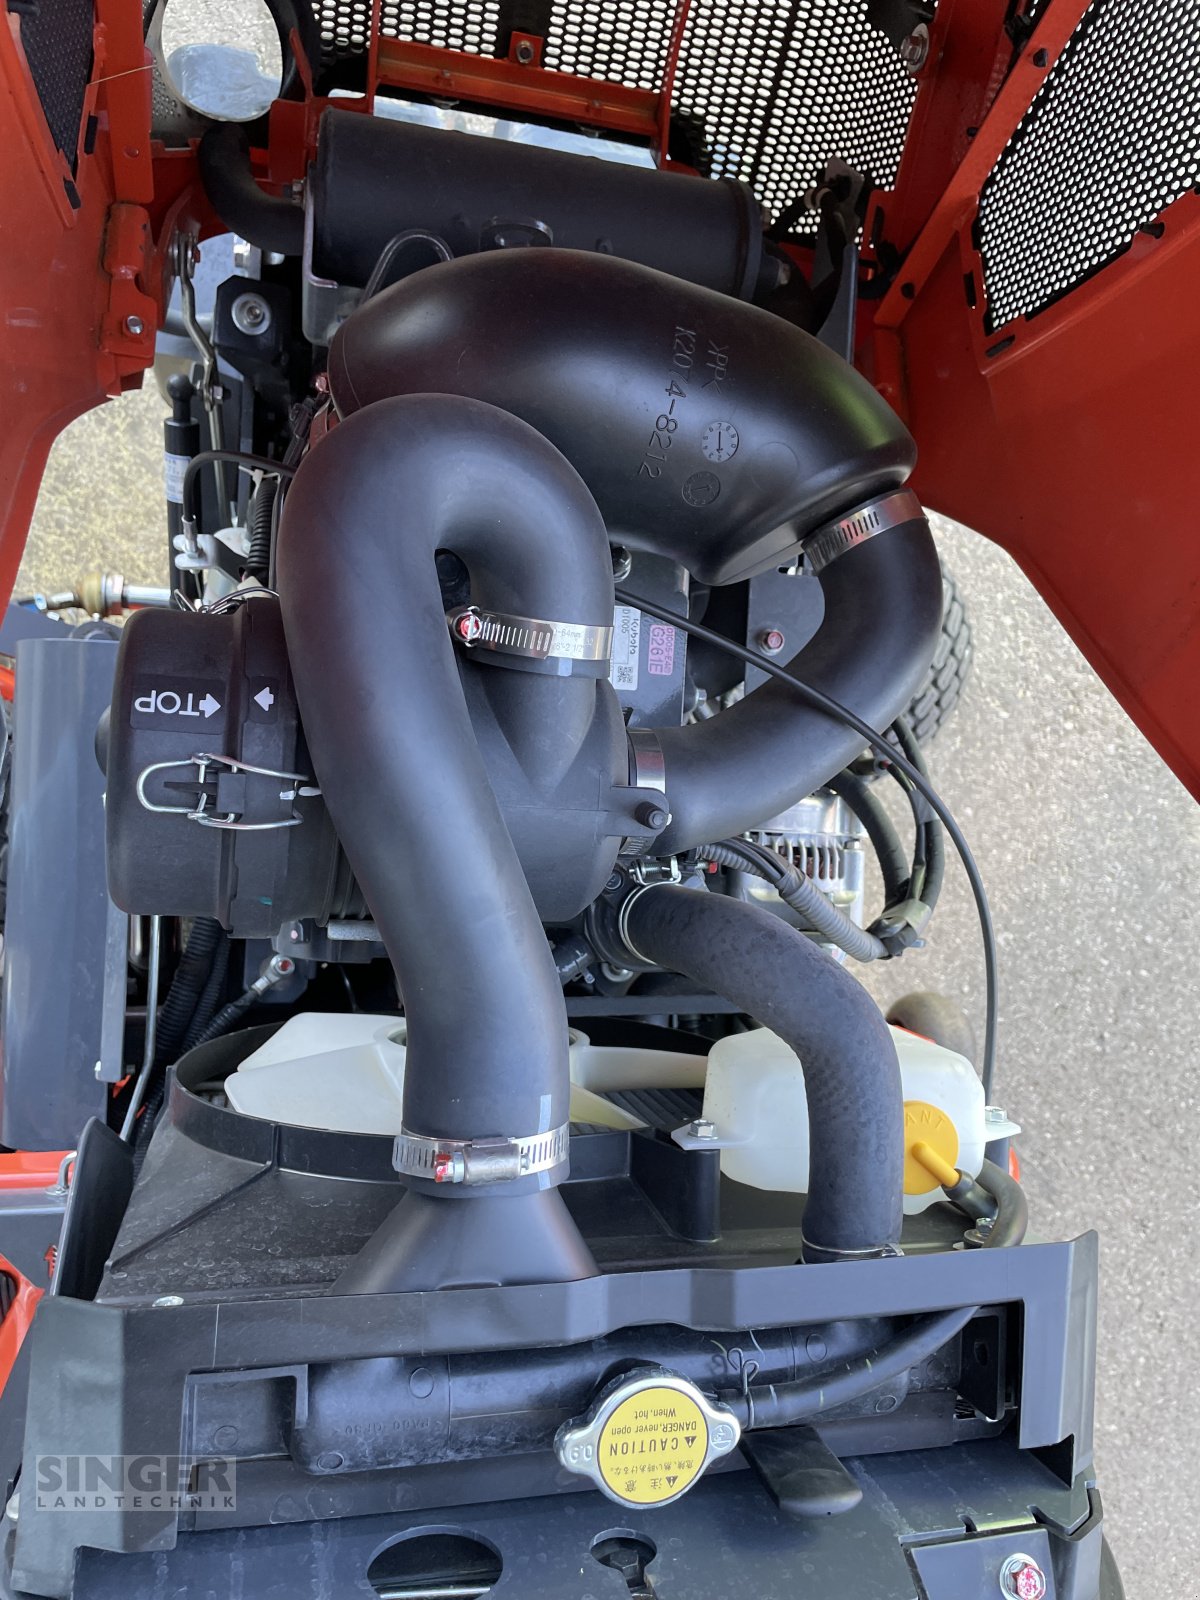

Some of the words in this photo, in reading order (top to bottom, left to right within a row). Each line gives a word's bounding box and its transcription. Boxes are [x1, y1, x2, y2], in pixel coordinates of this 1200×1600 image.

[638, 326, 697, 479] K2074-8212
[621, 609, 630, 634] D1005
[629, 618, 639, 655] Kubota
[649, 626, 666, 673] G261E
[134, 690, 200, 716] TOP
[611, 1426, 632, 1435] open
[570, 1445, 593, 1464] 0.9
[610, 1437, 679, 1456] CAUTION
